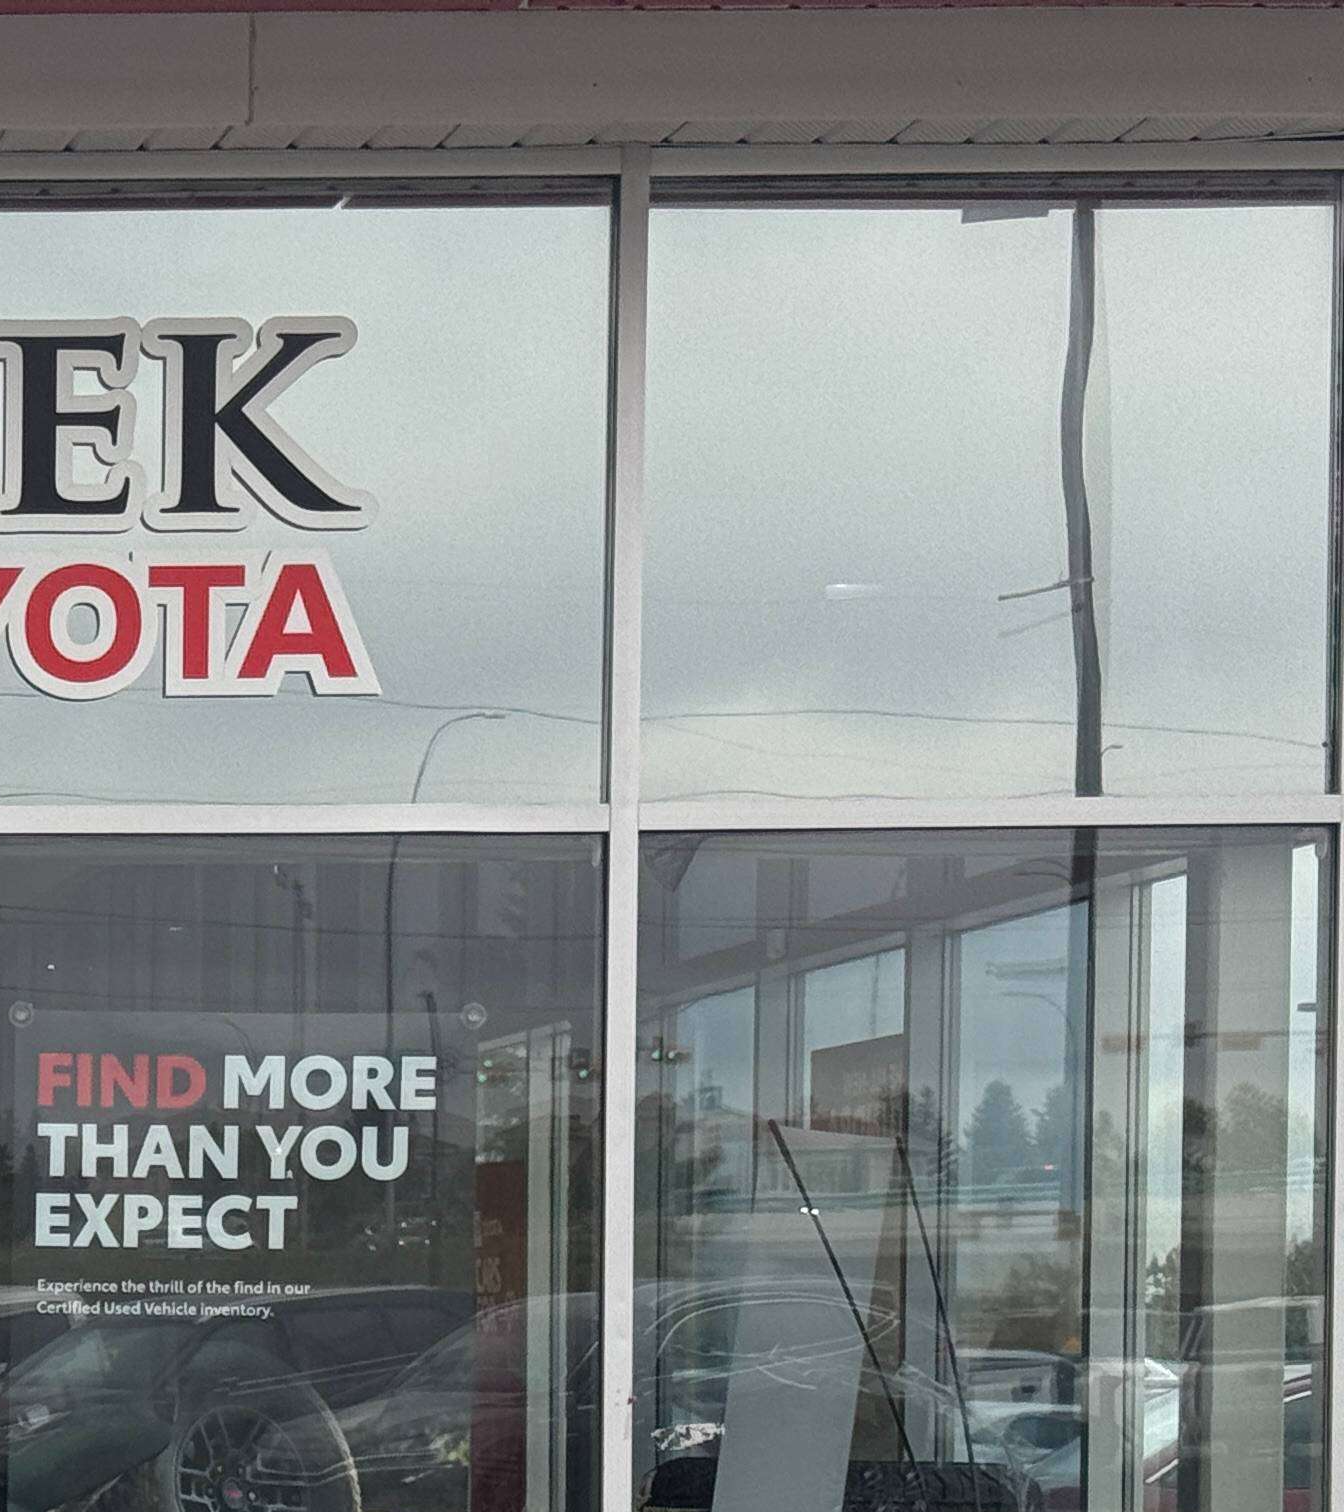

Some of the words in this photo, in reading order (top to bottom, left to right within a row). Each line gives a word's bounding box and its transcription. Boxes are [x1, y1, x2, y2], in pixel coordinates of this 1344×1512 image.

[36, 1052, 207, 1110] FIND
[222, 1054, 438, 1112] MORE
[36, 1123, 241, 1180] THAN
[255, 1124, 410, 1182] YOU
[33, 1192, 299, 1250] EXPECT
[36, 1278, 118, 1295] Experience
[120, 1279, 146, 1294] the
[148, 1279, 185, 1294] thrill
[186, 1279, 204, 1295] of
[204, 1280, 231, 1295] the
[233, 1280, 264, 1295] find
[267, 1280, 282, 1295] in
[284, 1283, 311, 1296] our
[36, 1300, 101, 1316] Certified
[103, 1301, 142, 1316] Used
[143, 1302, 197, 1317] Vehicle
[199, 1302, 275, 1320] inventory.
